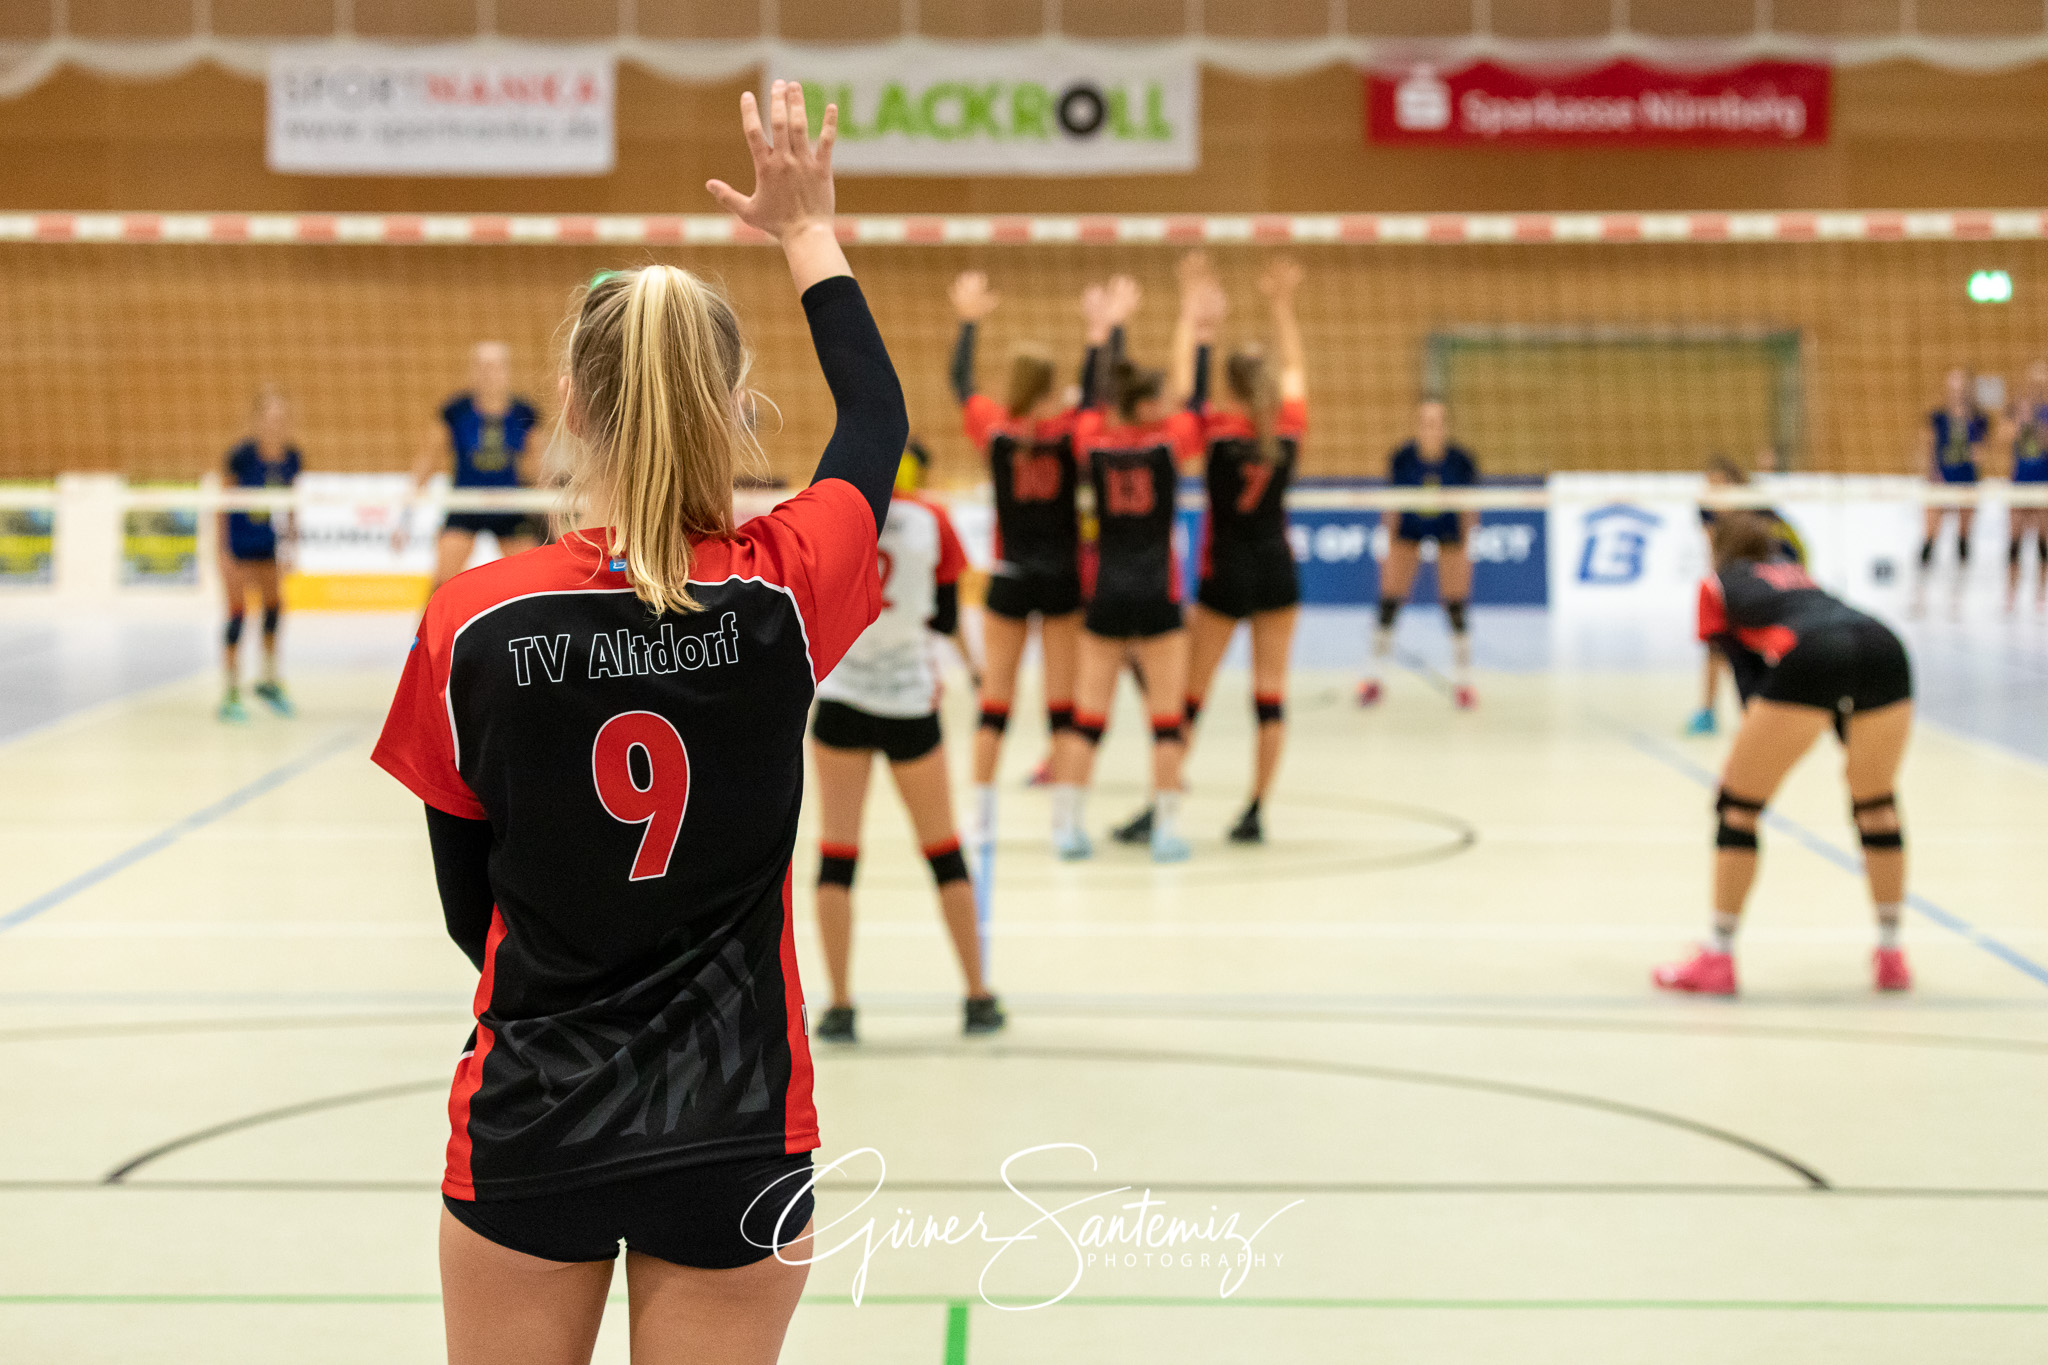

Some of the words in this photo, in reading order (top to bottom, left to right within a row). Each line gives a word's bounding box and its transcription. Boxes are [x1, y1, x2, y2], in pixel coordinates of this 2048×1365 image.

[801, 80, 1170, 141] BLACKROLL
[1462, 92, 1633, 136] Sparkasse
[1237, 462, 1274, 513] 7
[1313, 523, 1367, 563] OF
[508, 633, 571, 686] TV
[588, 611, 739, 680] Altdorf
[592, 710, 691, 881] 9
